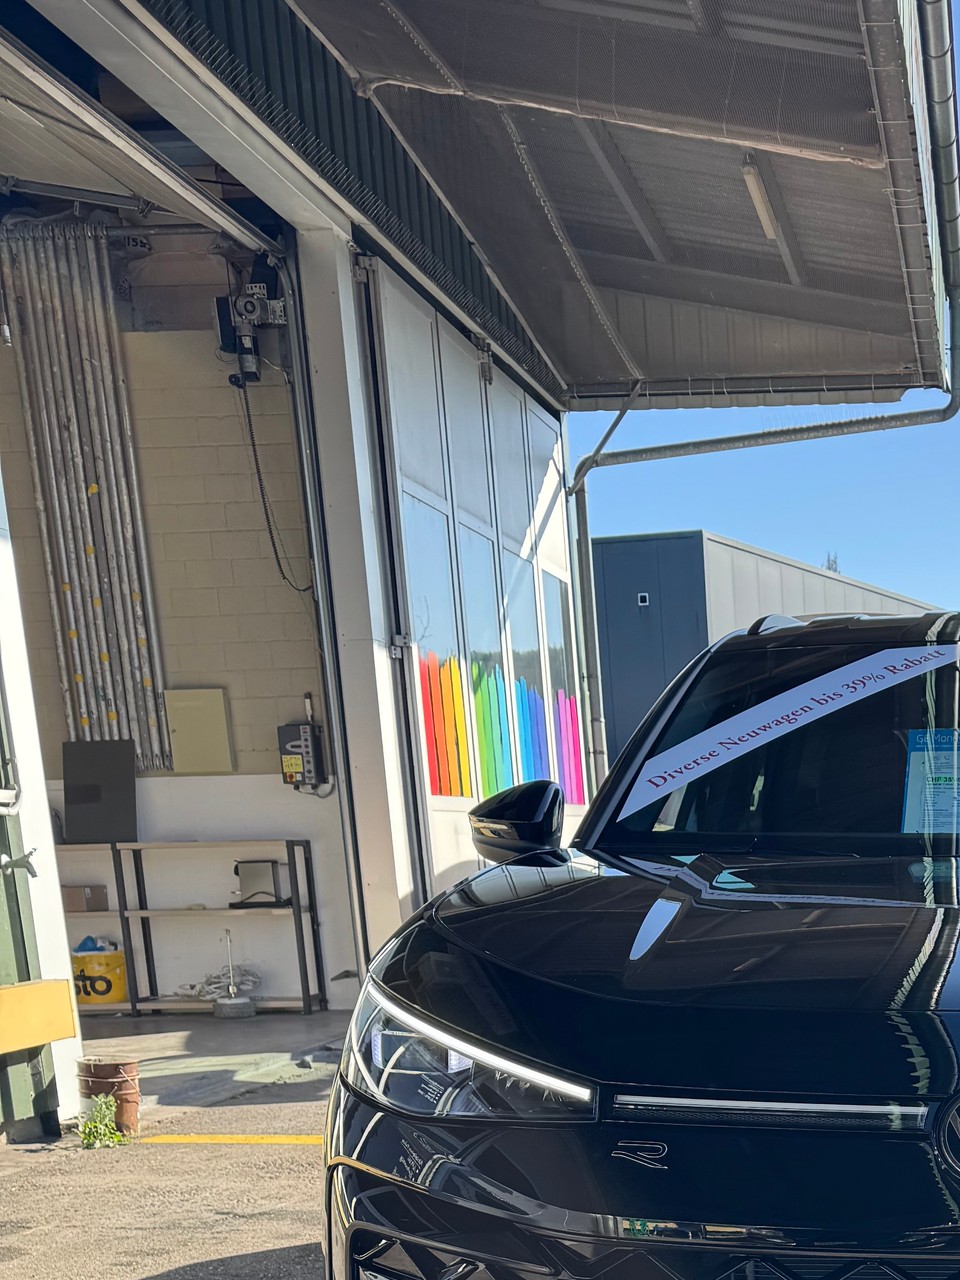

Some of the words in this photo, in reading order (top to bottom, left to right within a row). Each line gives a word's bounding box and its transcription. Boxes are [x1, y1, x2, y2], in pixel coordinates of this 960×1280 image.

[646, 749, 720, 788] Diverse
[716, 704, 815, 751] Neuwagen
[811, 689, 844, 706] bis
[841, 672, 886, 694] 39%
[883, 649, 947, 675] Rabatt
